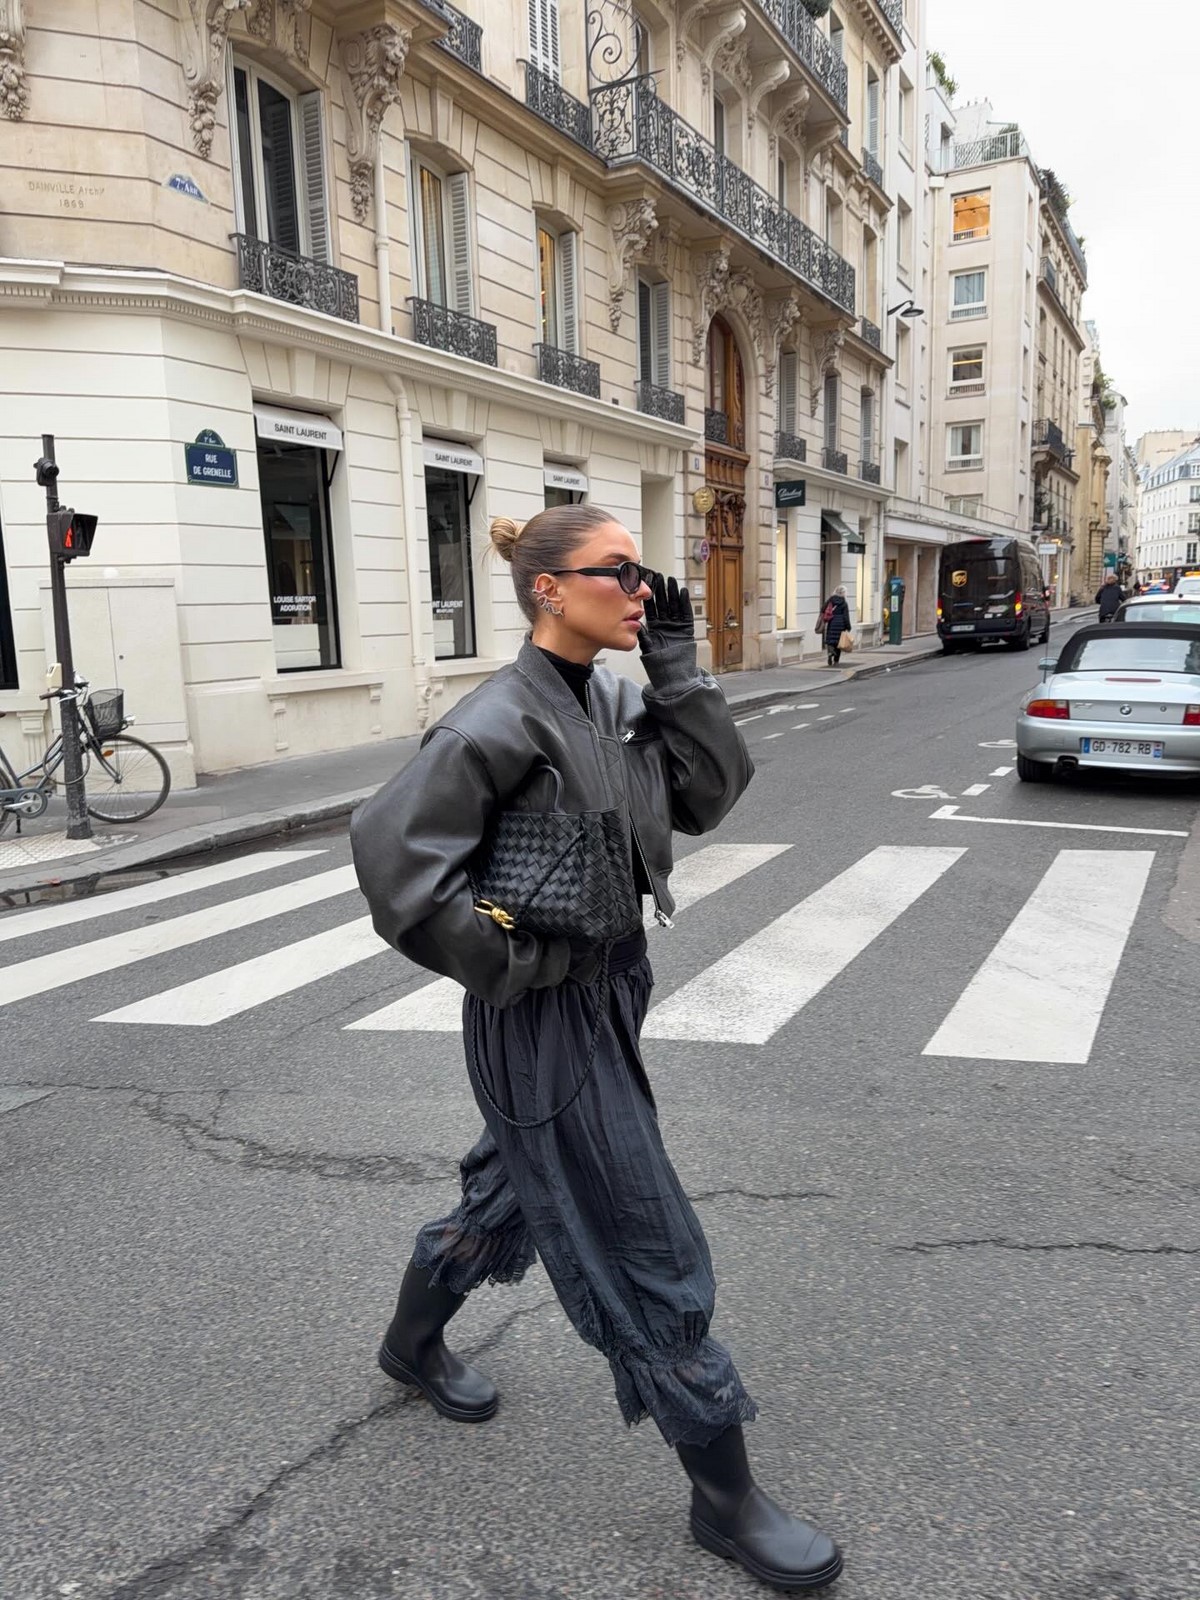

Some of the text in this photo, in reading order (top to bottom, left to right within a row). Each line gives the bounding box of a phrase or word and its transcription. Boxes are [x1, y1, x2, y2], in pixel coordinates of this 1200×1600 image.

[274, 423, 328, 440] SAINT LAURENT
[205, 453, 218, 464] RUE
[435, 453, 472, 466] SAINT LAURENT
[193, 465, 232, 479] DE GRENELLE
[273, 595, 294, 603] LOUISE
[440, 600, 464, 609] LAURENT
[280, 604, 312, 612] ADORATION
